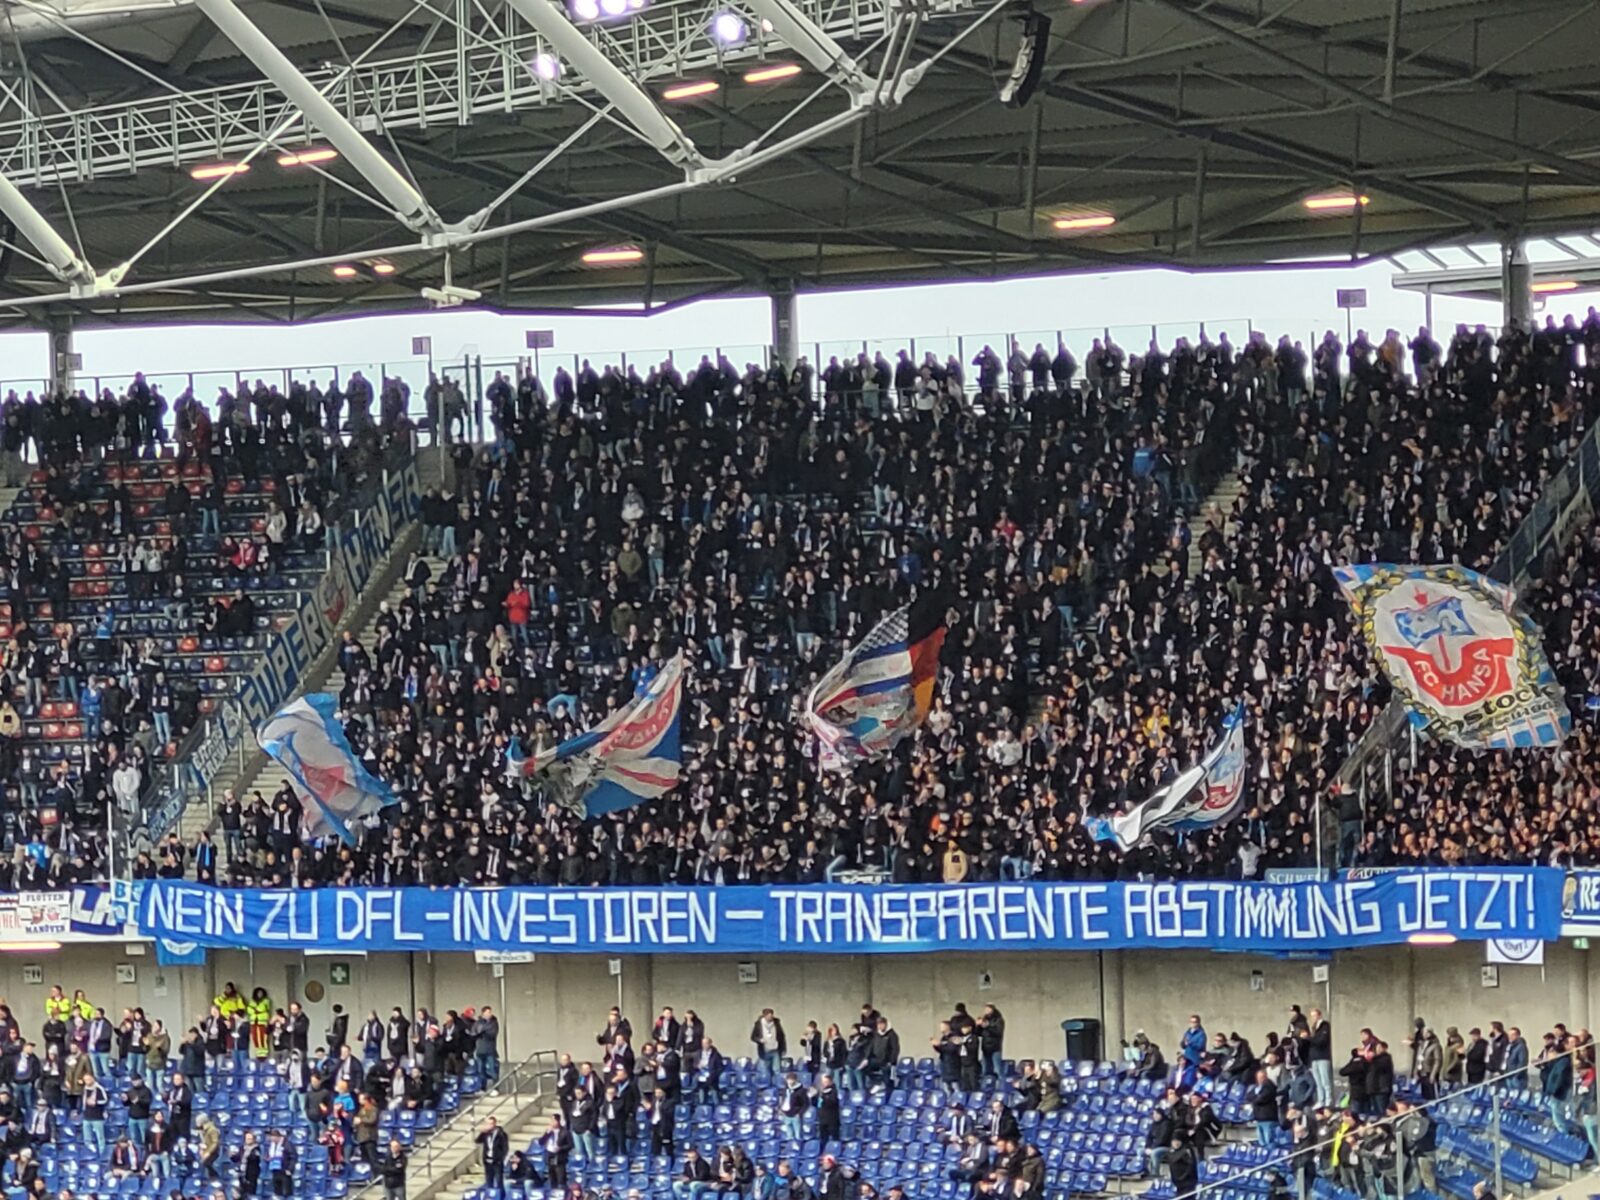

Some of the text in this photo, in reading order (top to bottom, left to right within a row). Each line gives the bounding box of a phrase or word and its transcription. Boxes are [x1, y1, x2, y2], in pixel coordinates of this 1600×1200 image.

[238, 604, 336, 729] SUPER
[1414, 647, 1491, 702] FC HANSA
[148, 883, 244, 935] NEIN
[259, 886, 318, 940] ZU
[770, 886, 1109, 942] TRANSPARENTE
[1124, 884, 1381, 938] ABSTIMMUNG
[1396, 873, 1534, 931] JETZT!
